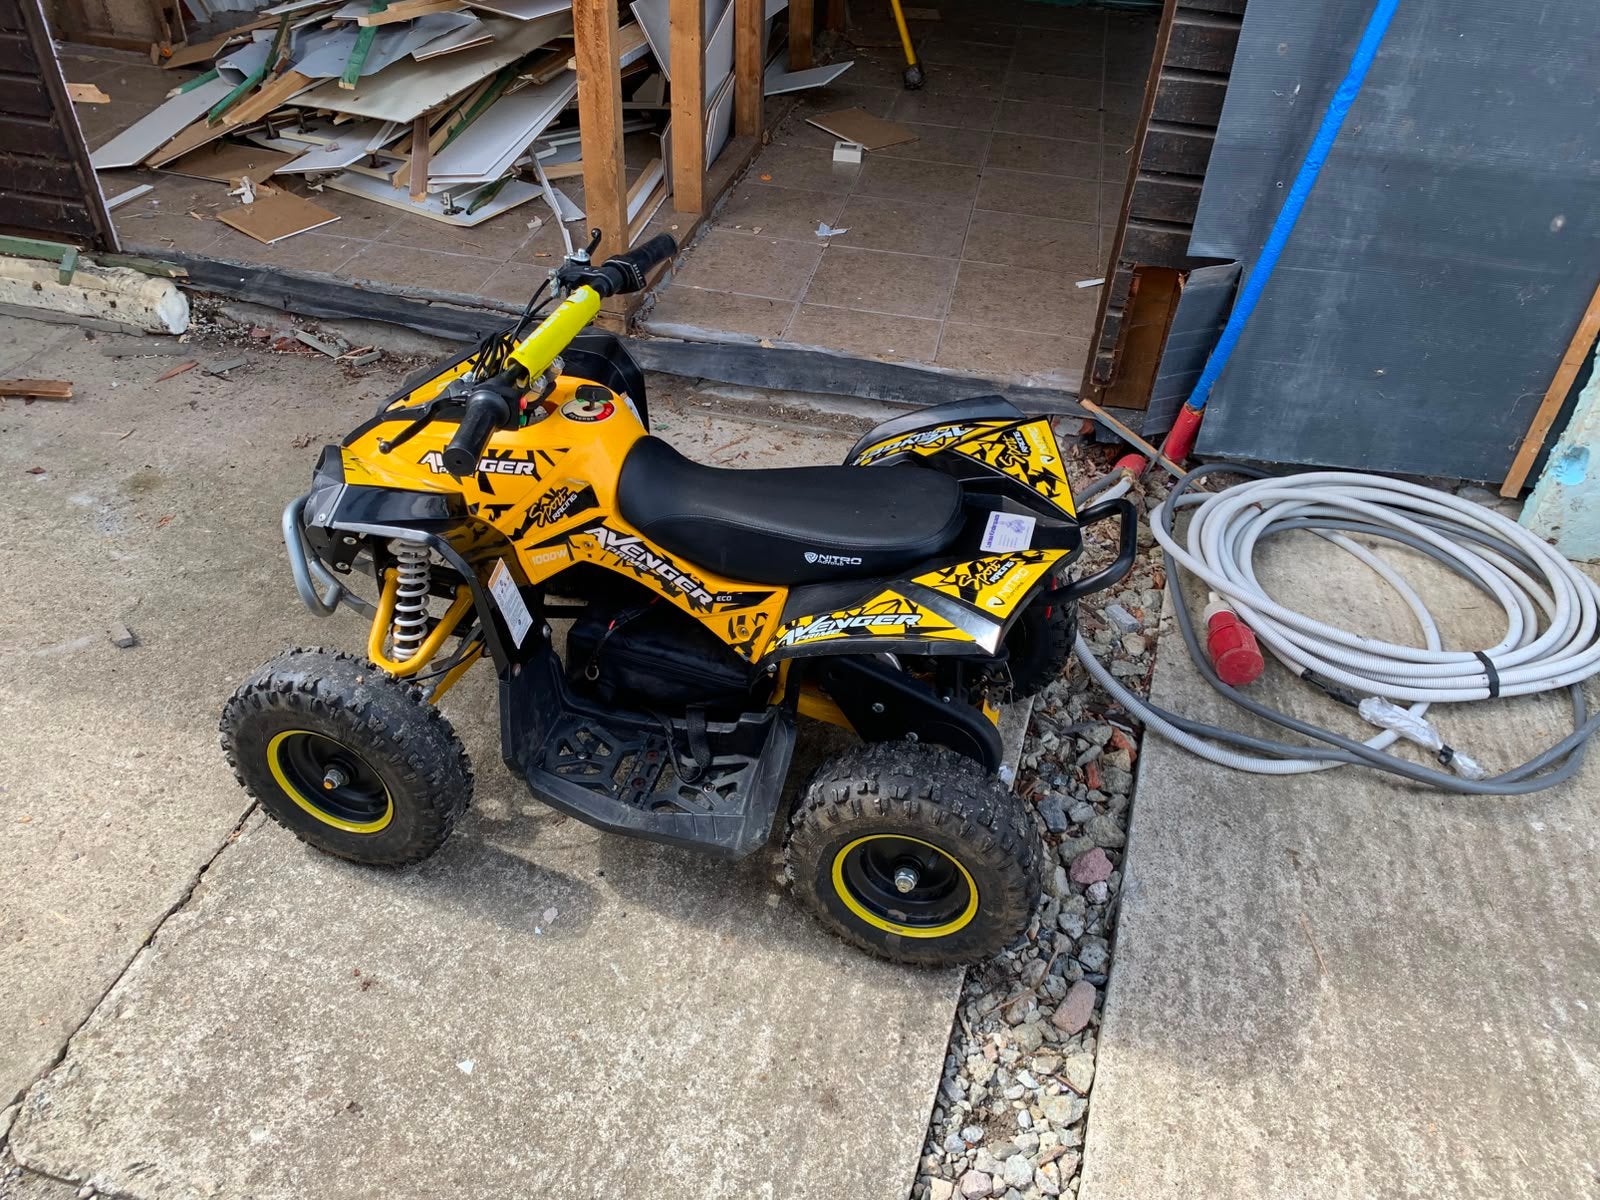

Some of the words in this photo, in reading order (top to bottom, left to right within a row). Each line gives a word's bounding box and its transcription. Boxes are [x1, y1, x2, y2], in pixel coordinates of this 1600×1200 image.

[419, 452, 535, 475] AGER
[529, 488, 567, 527] Sport
[551, 493, 578, 521] RACING
[583, 527, 714, 606] AVENGER
[604, 545, 650, 572] PRIME
[818, 553, 863, 565] NITRO
[989, 560, 1015, 583] RACING
[958, 559, 1001, 590] Sport
[716, 594, 733, 602] ECO
[775, 614, 922, 646] AVENGER
[796, 628, 842, 642] PRIME
